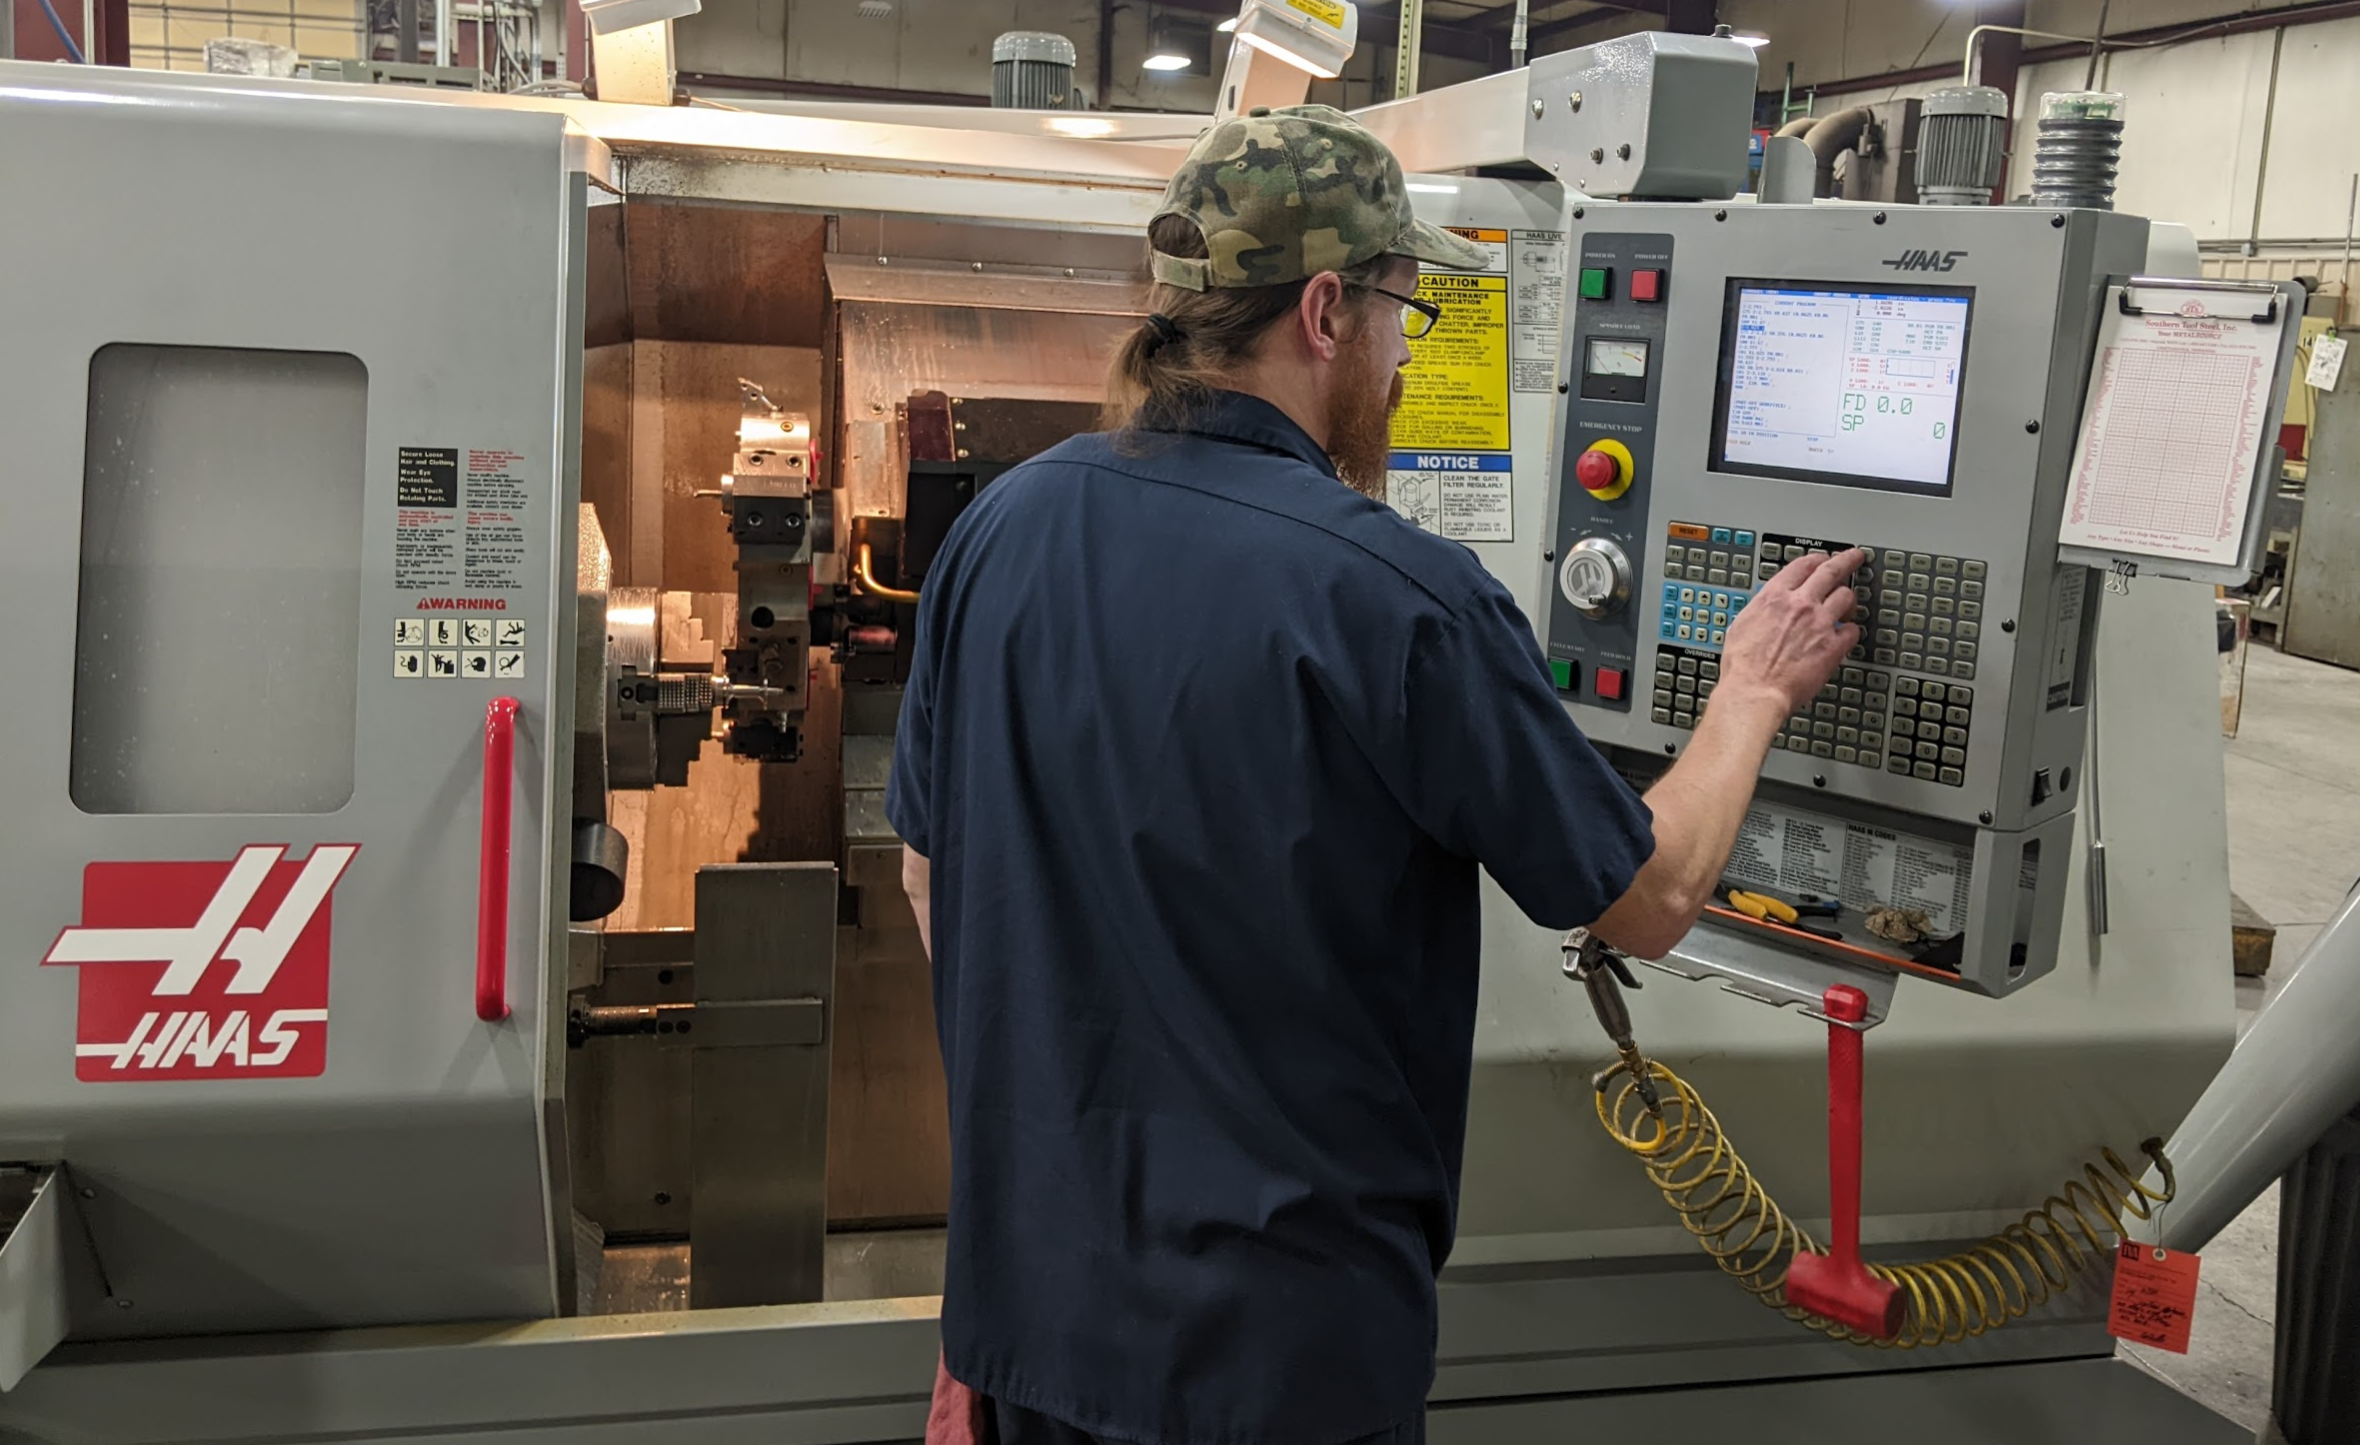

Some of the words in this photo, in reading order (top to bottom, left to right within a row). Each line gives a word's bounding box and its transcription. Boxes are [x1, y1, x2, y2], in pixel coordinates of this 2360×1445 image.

[1882, 249, 1968, 272] HAAS
[1421, 276, 1479, 287] CAUTION
[1432, 292, 1489, 300] MAINTENANCE
[2145, 320, 2180, 328] Southern
[1843, 393, 1867, 411] FD
[1877, 396, 1913, 415] 0.0
[1580, 421, 1621, 431] EMERGENCY
[1622, 425, 1643, 433] STOP
[1841, 414, 1865, 431] SP
[1933, 422, 1946, 439] 0
[1417, 455, 1480, 469] NOTICE
[1679, 527, 1698, 535] RESET
[1795, 538, 1823, 547] DISPLAY
[429, 597, 507, 610] WARNING
[1684, 648, 1716, 659] OVERRIDES
[1930, 686, 1937, 694] 8
[1926, 727, 1932, 735] 2
[1952, 732, 1958, 740] 3
[1848, 824, 1866, 834] HAAS
[1874, 830, 1897, 841] CODES
[75, 1009, 328, 1069] HAAS
